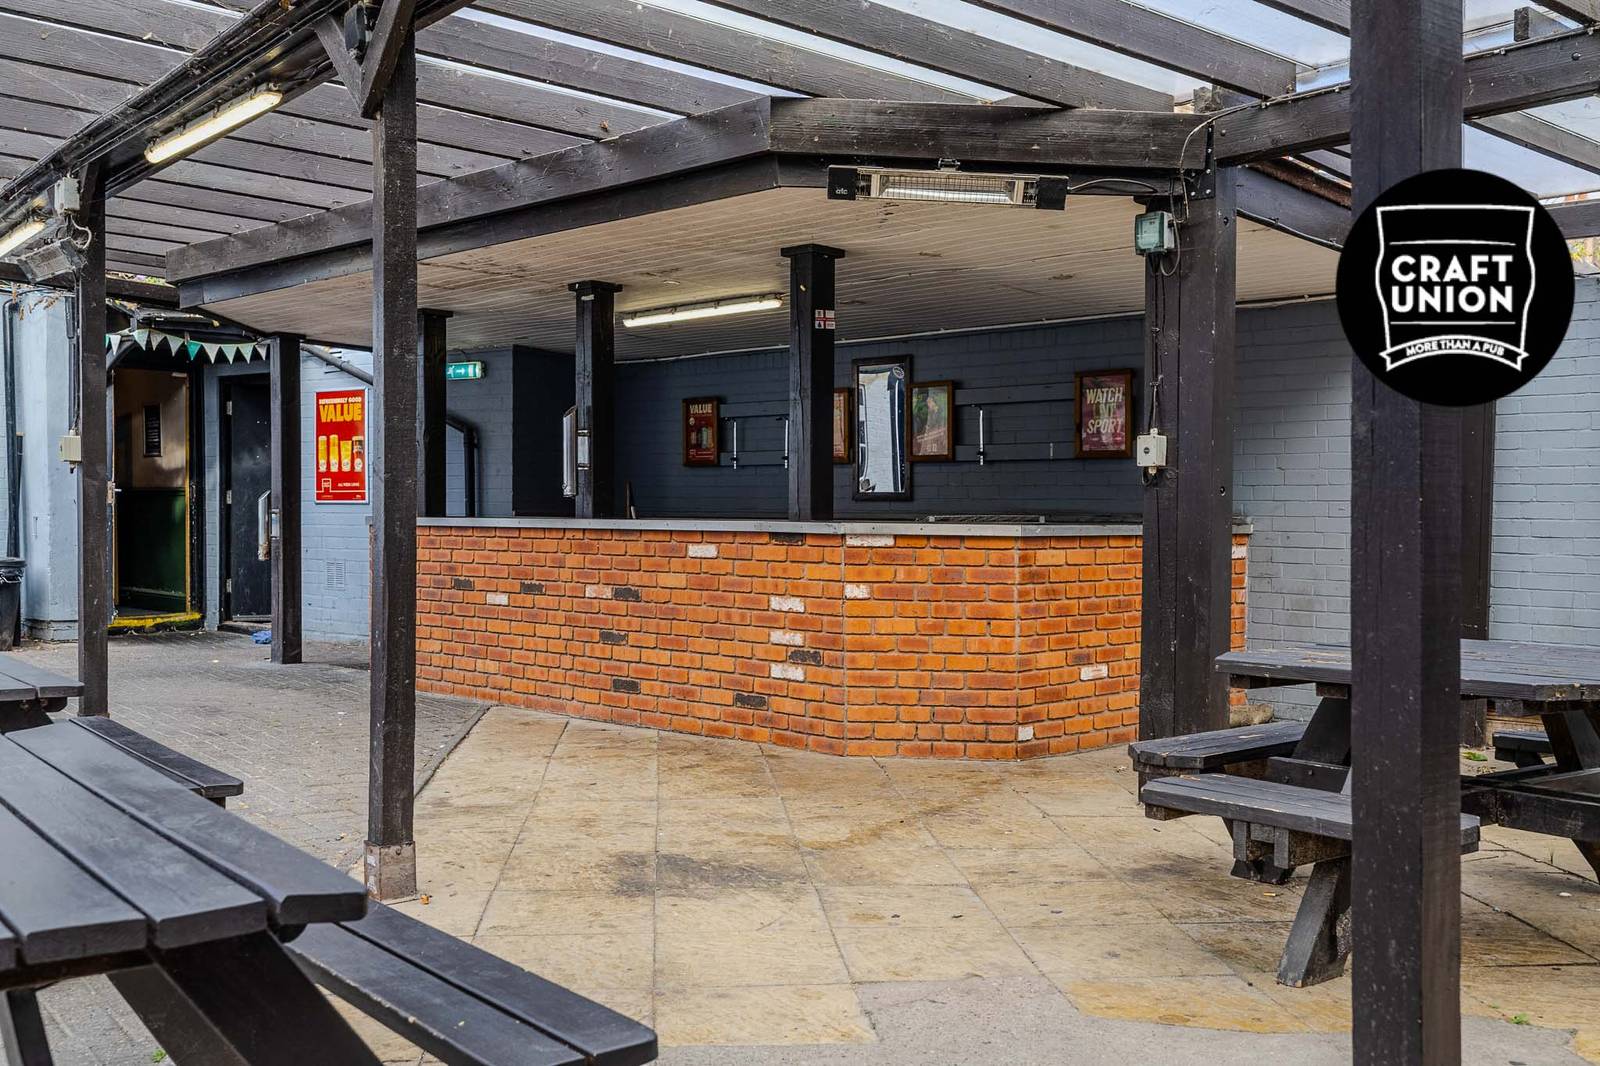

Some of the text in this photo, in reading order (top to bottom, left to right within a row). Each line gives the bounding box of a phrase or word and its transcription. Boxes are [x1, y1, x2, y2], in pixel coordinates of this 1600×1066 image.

[1086, 387, 1124, 404] WATCH
[319, 402, 362, 423] VALUE
[689, 403, 713, 414] VALUE
[1086, 418, 1123, 434] SPORT
